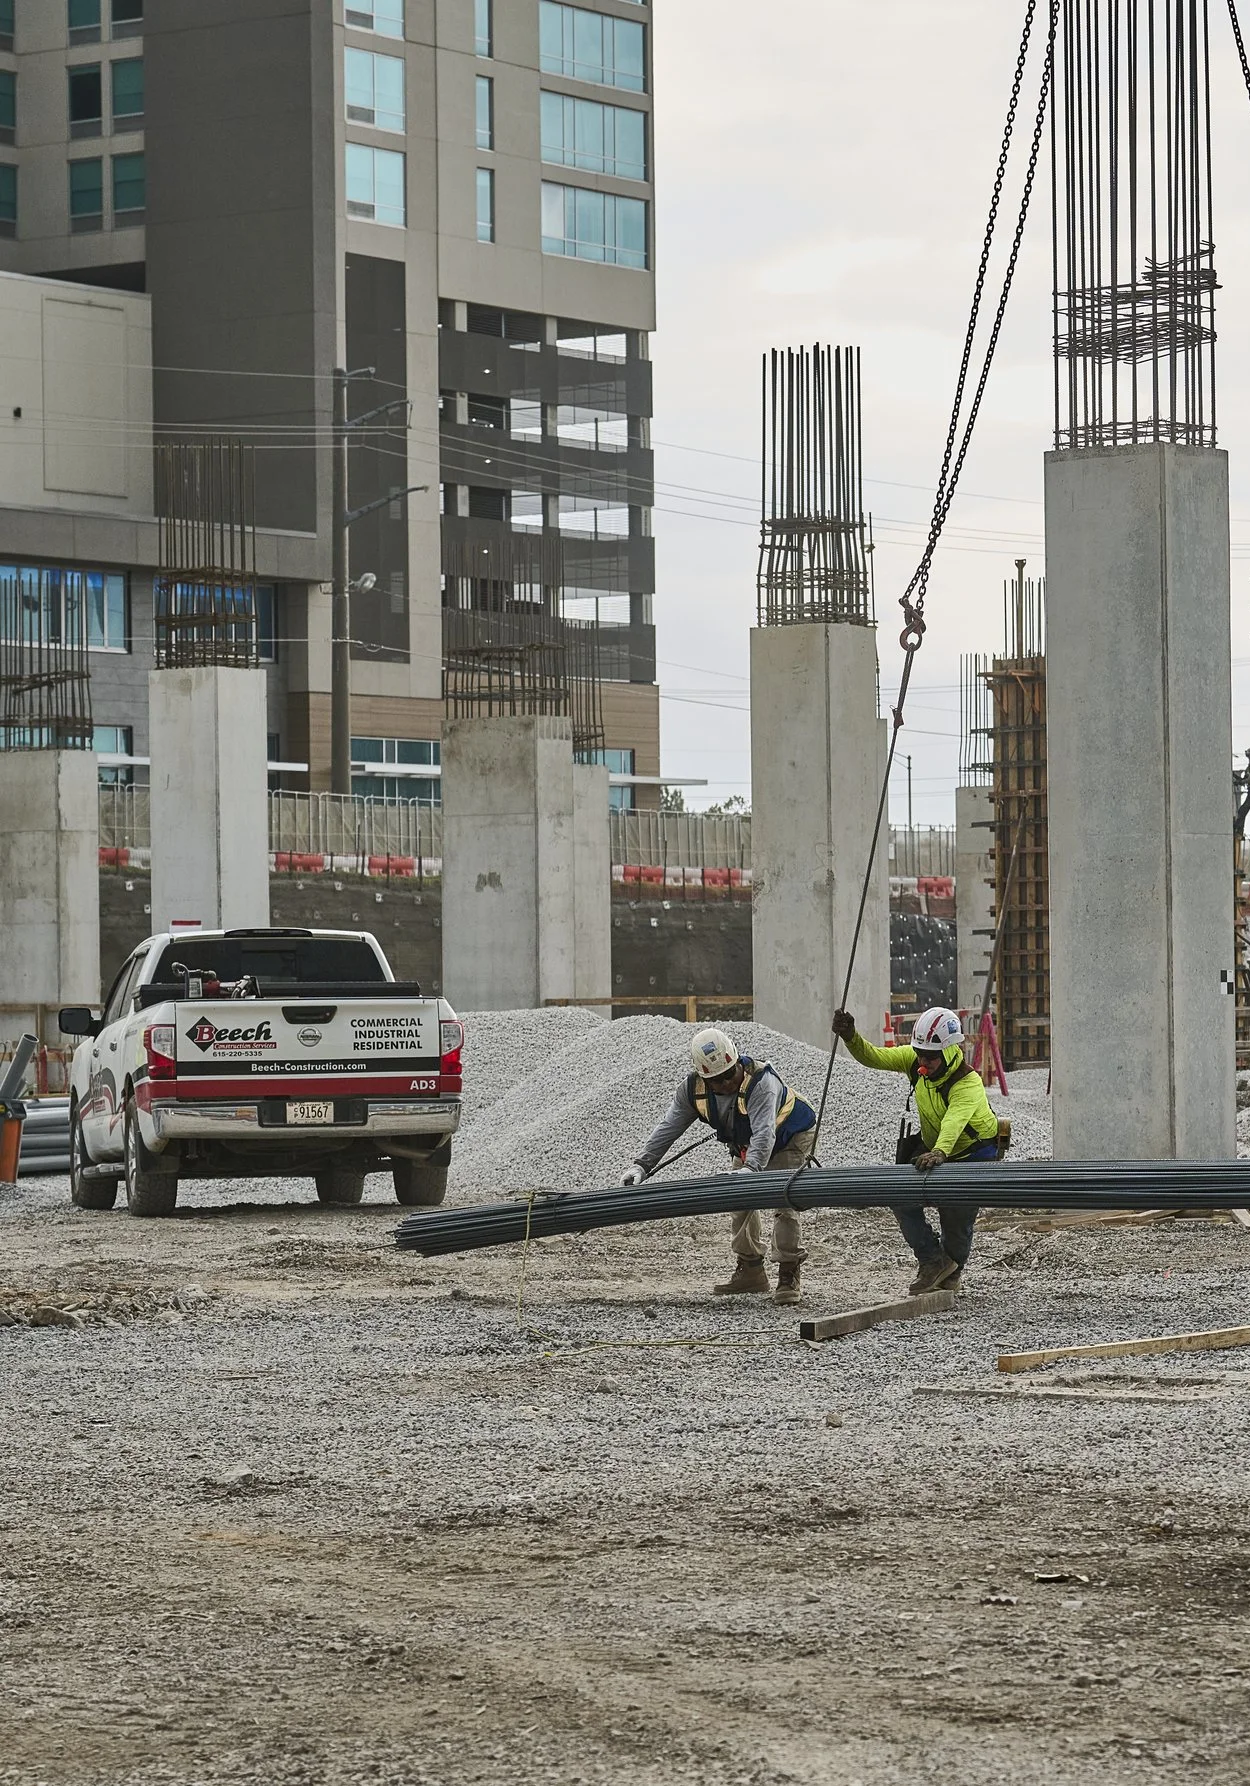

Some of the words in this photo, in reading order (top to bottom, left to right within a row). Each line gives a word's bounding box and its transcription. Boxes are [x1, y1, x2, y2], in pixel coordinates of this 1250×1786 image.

[350, 1017, 423, 1028] COMMERCIAL
[194, 1020, 272, 1042] Beech
[354, 1029, 421, 1039] INDUSTRIAL
[353, 1040, 423, 1051] RESIDENTIAL
[251, 1062, 367, 1072] Beech-Construction.com
[409, 1079, 437, 1090] AD3
[299, 1105, 329, 1119] 91567
